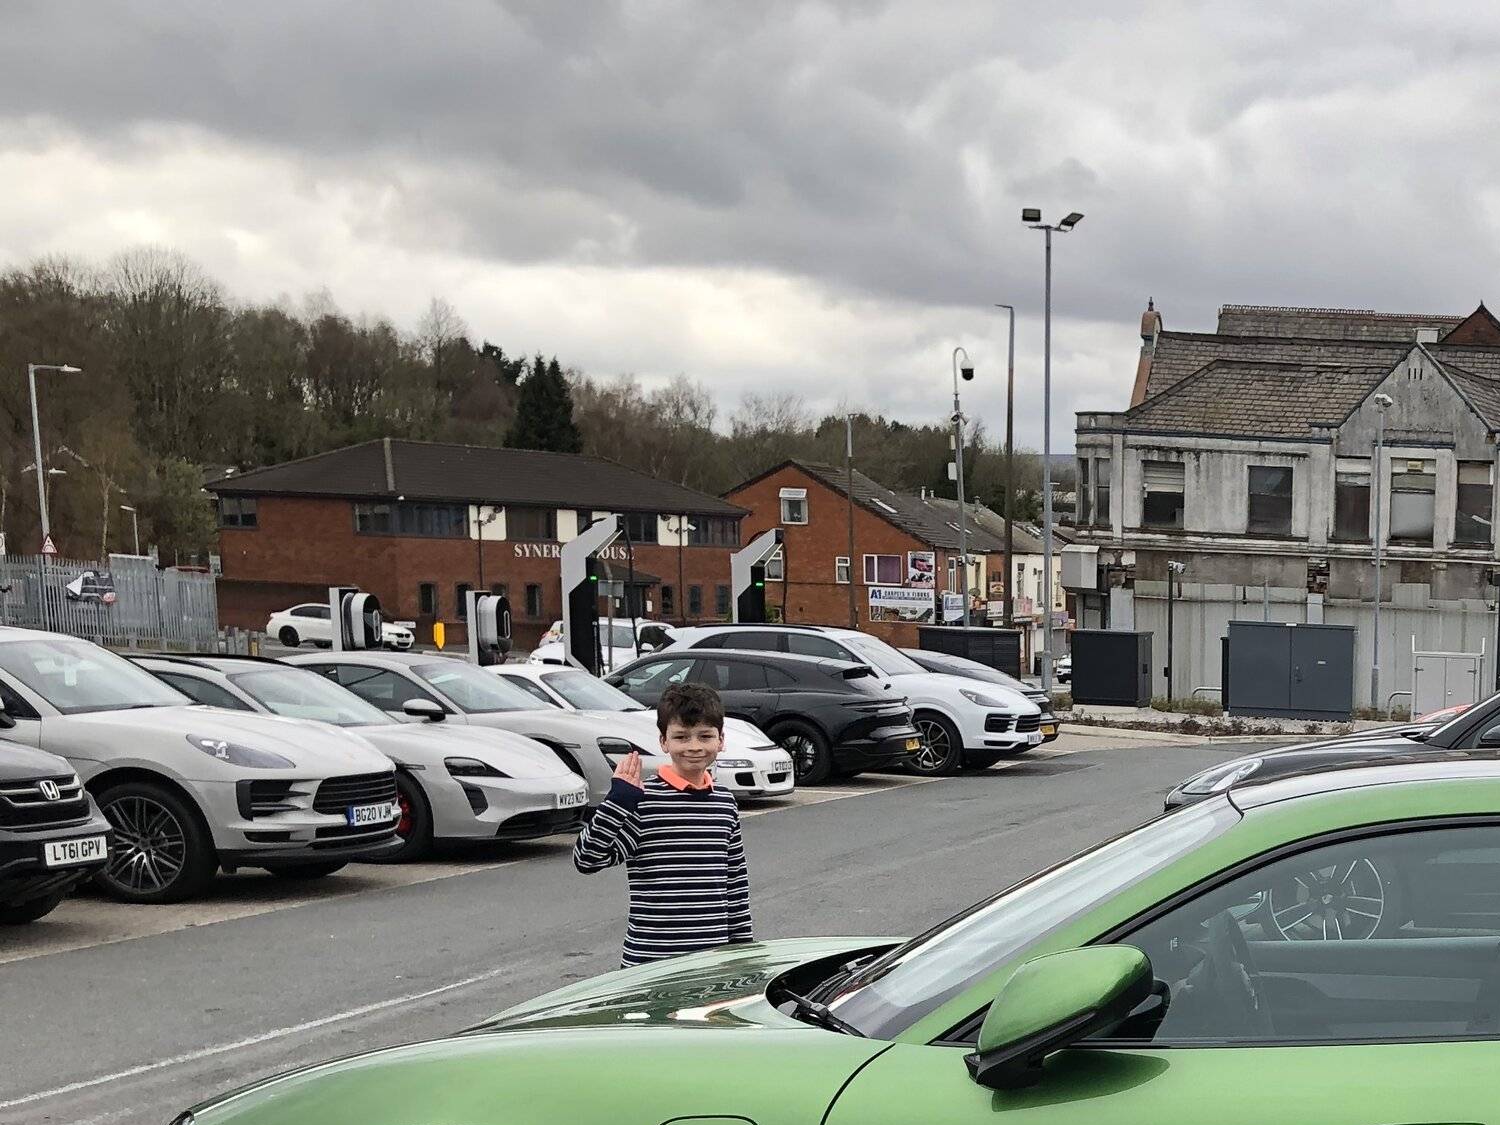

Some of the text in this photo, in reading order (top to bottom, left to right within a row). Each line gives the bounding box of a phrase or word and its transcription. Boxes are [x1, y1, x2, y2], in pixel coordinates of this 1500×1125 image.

[514, 543, 635, 560] SYNER OUSE
[871, 589, 881, 599] A1
[356, 806, 377, 823] BG20
[53, 839, 101, 861] LT61 GPV
